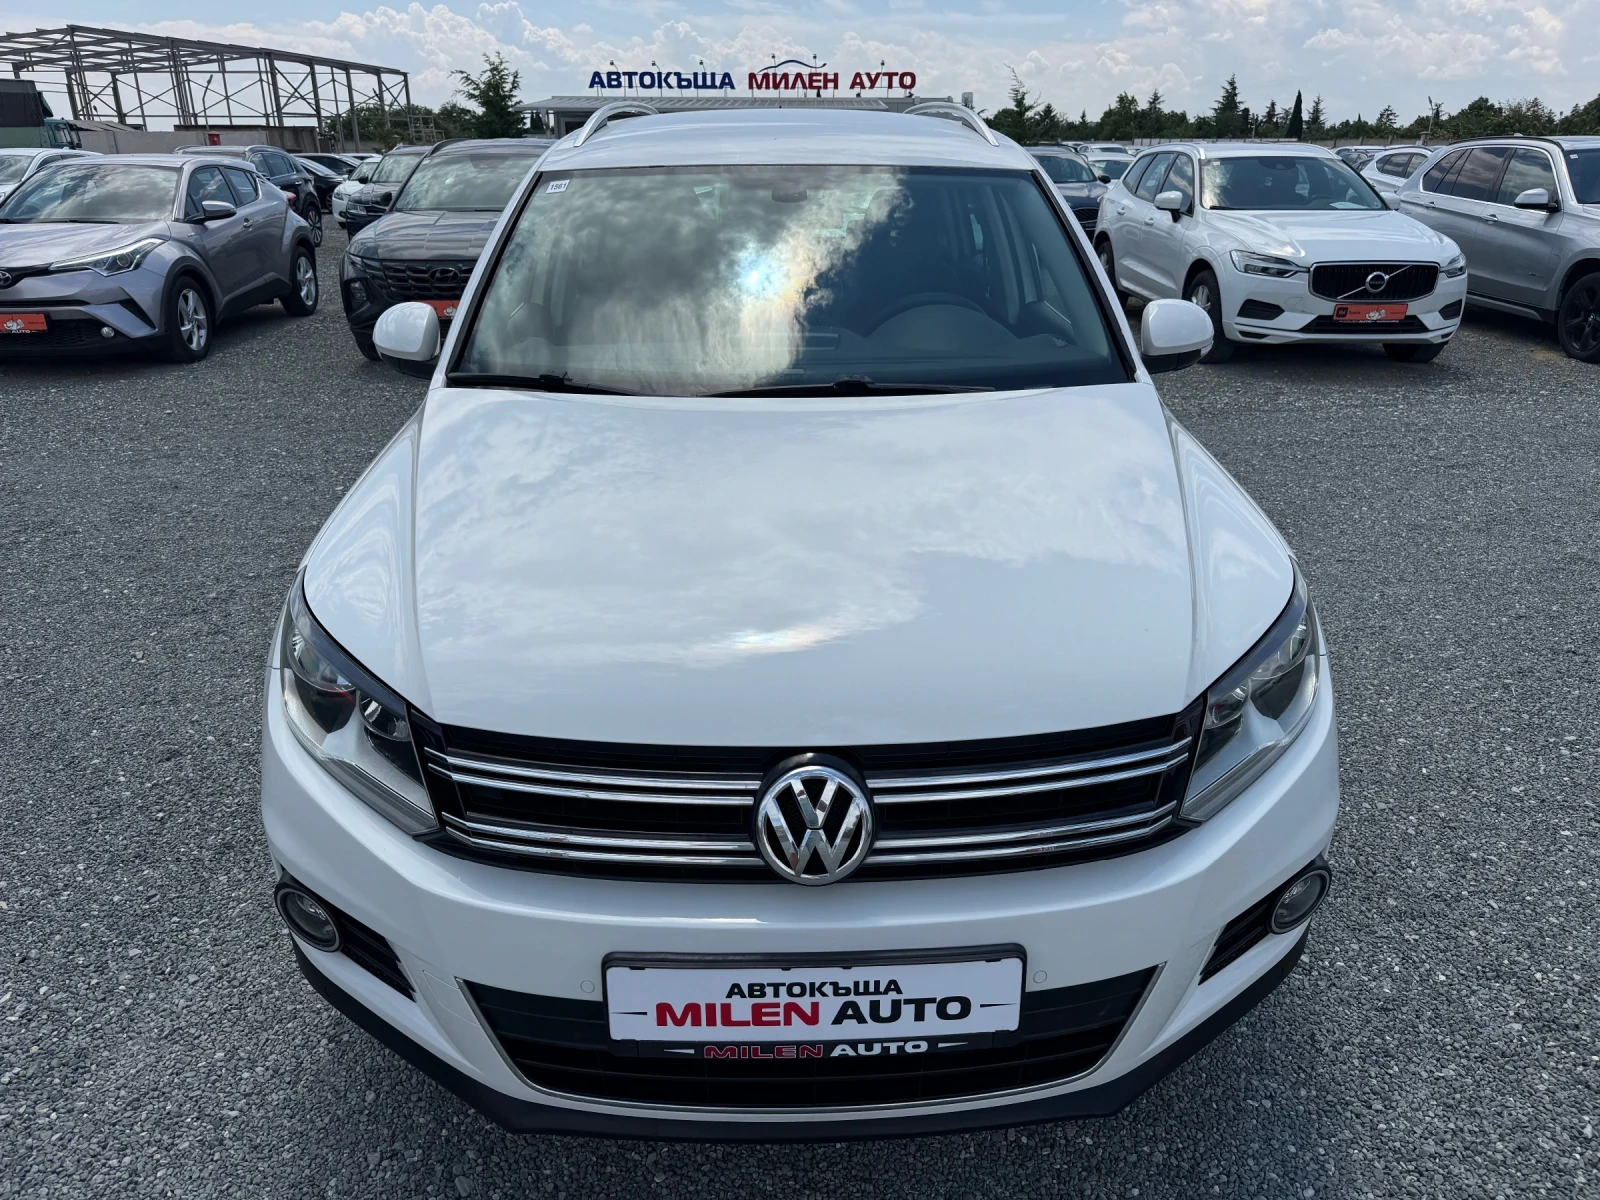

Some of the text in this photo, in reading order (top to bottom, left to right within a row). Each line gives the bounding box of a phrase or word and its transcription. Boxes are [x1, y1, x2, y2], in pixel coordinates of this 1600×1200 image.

[588, 71, 917, 90] АВТОКЪЩА МИЛЕН АУТО
[550, 182, 567, 190] 1561
[725, 979, 904, 999] АВТОКЪЩА
[655, 995, 972, 1027] MILEN AUTO
[703, 1040, 929, 1059] MILEN AUTO
